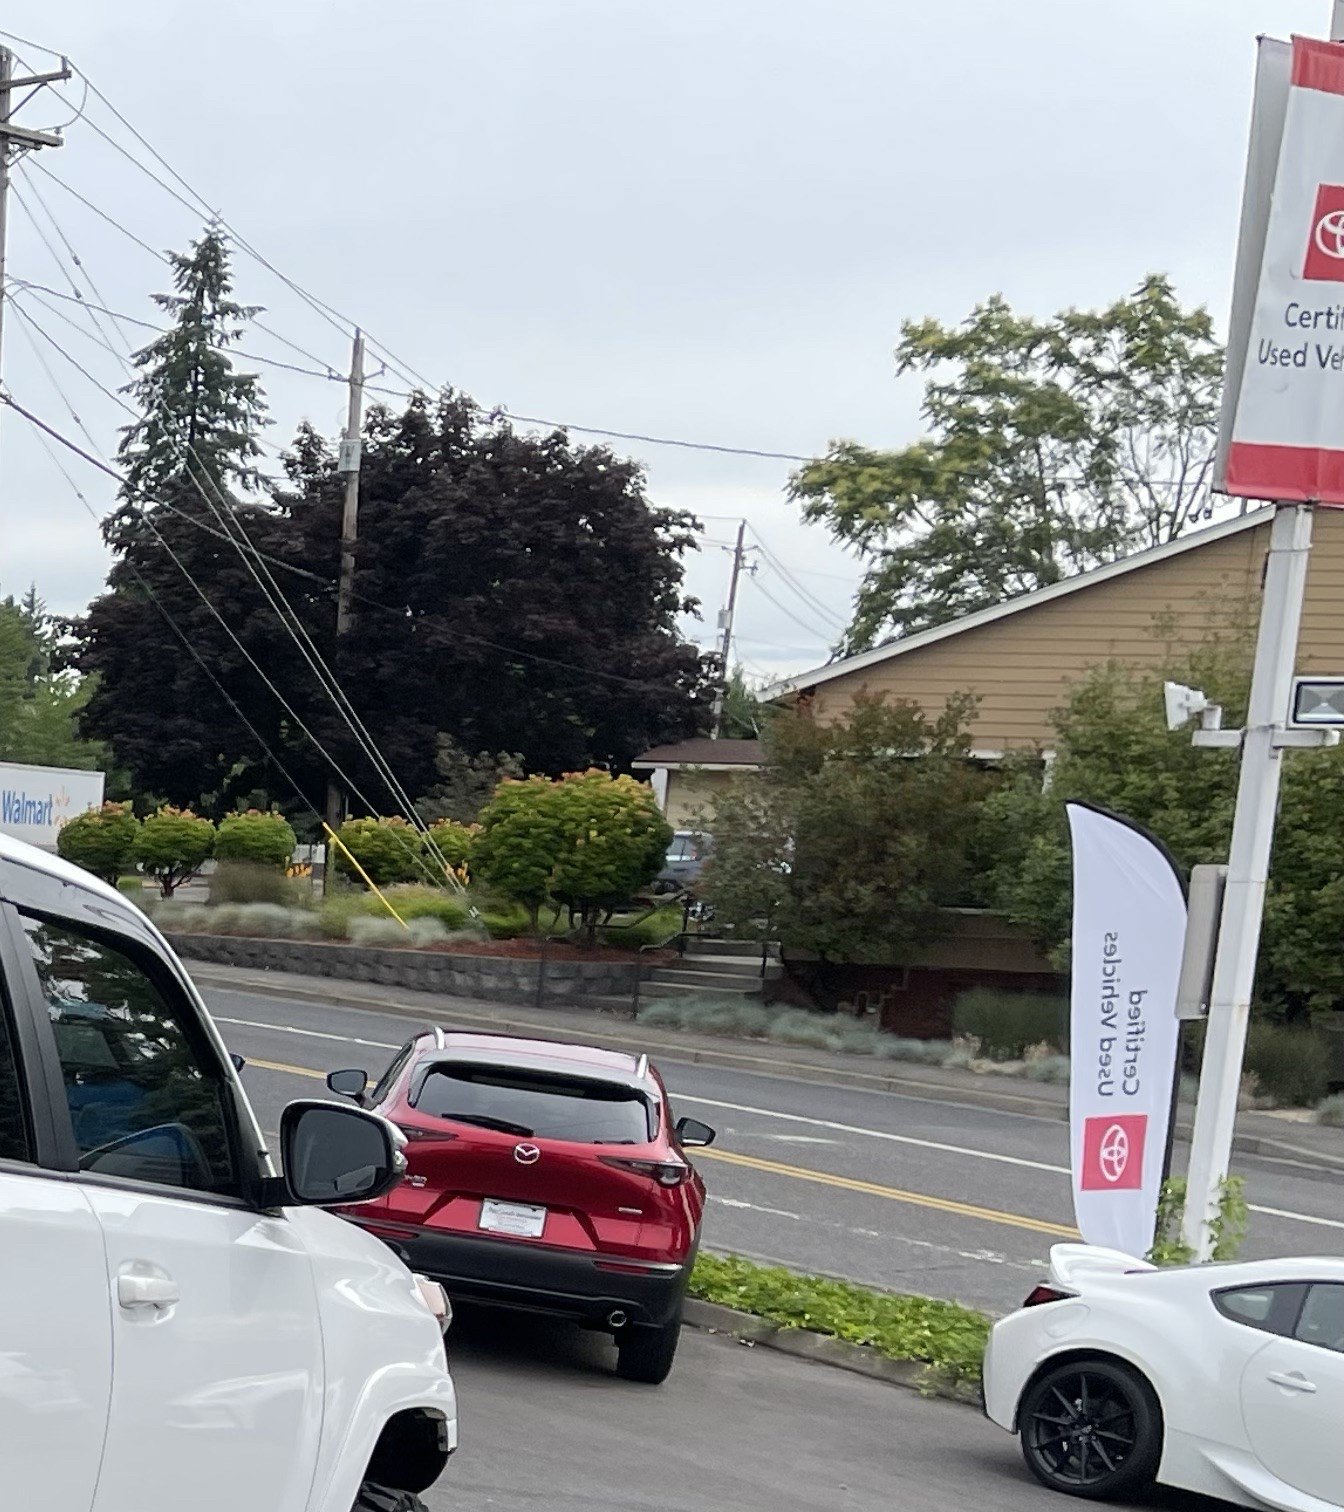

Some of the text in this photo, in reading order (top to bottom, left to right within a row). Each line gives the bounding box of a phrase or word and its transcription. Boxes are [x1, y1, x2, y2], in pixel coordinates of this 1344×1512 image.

[1258, 338, 1344, 371] Used Ve
[2, 790, 53, 826] Walmart
